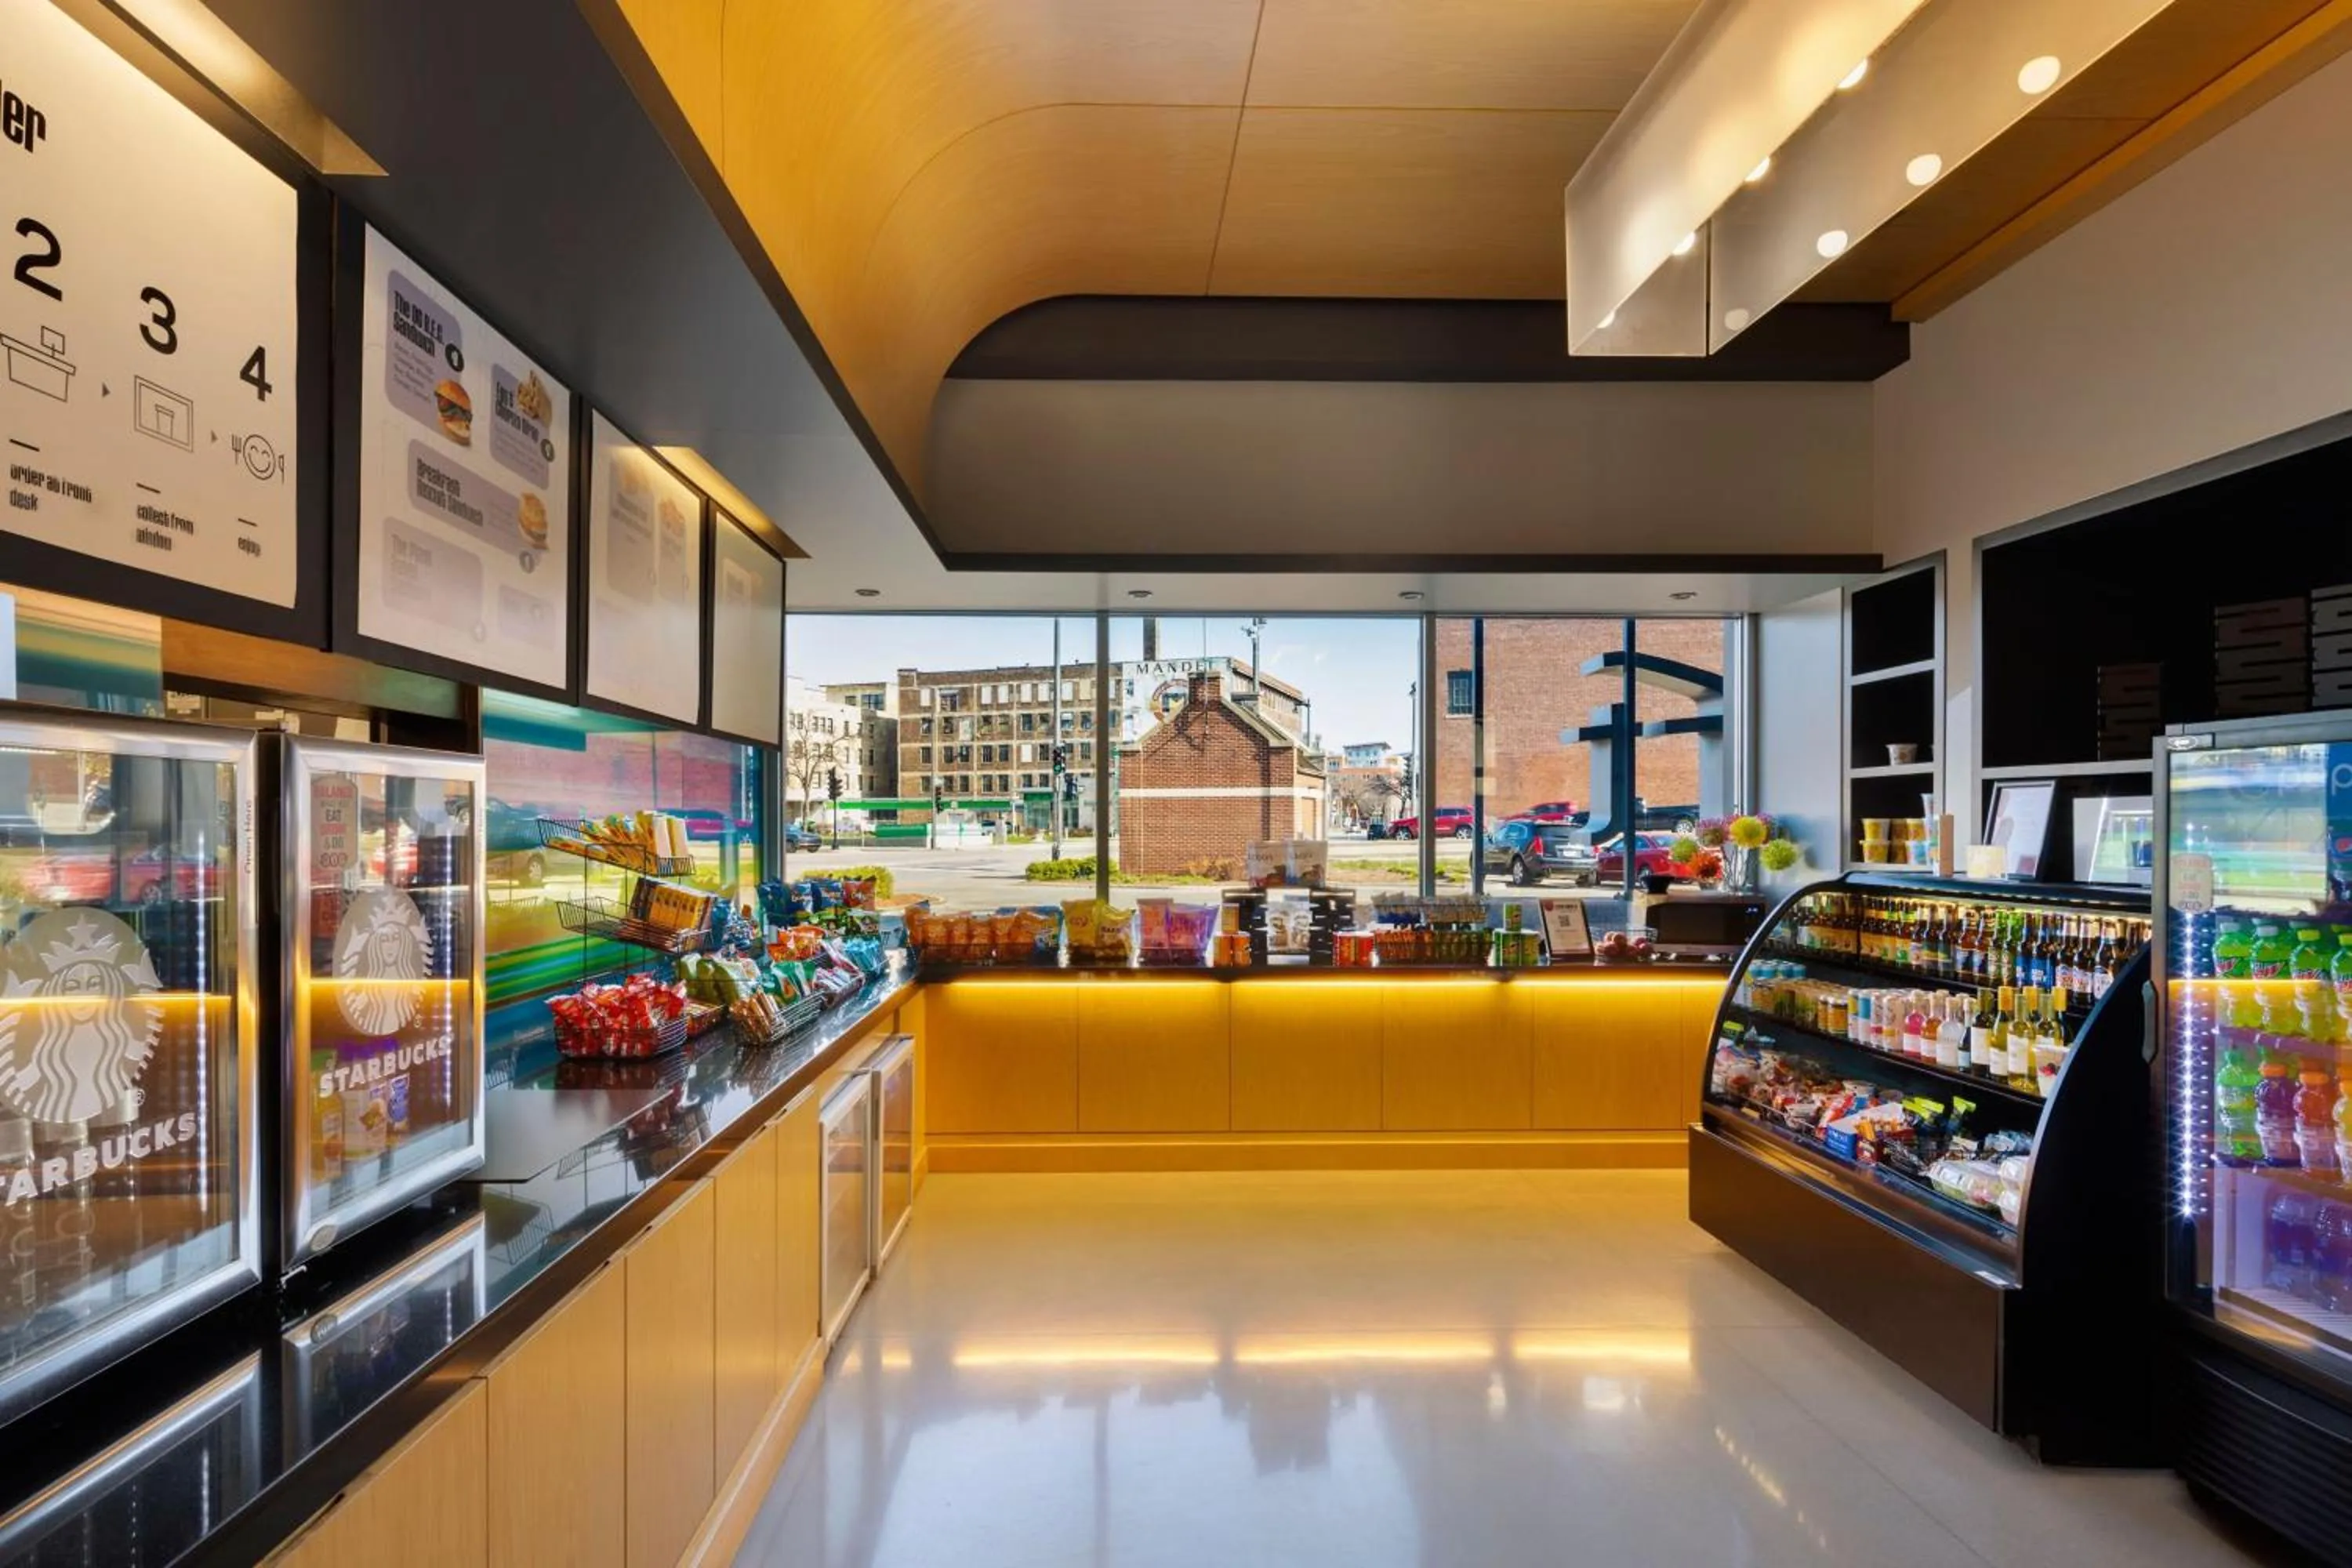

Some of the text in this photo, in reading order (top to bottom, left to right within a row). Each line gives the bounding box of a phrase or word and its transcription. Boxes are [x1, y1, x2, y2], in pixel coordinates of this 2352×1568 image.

[14, 217, 63, 302] 2
[139, 286, 178, 355] 3
[394, 290, 411, 319] The
[239, 345, 273, 402] 4
[10, 464, 45, 488] order
[61, 478, 93, 503] front
[417, 458, 460, 498] Breakfast
[9, 488, 38, 511] desk
[136, 504, 194, 536] collect from
[136, 528, 172, 552] window
[319, 1034, 453, 1098] STARBUCKS
[0, 1111, 197, 1207] ARBUCKS
